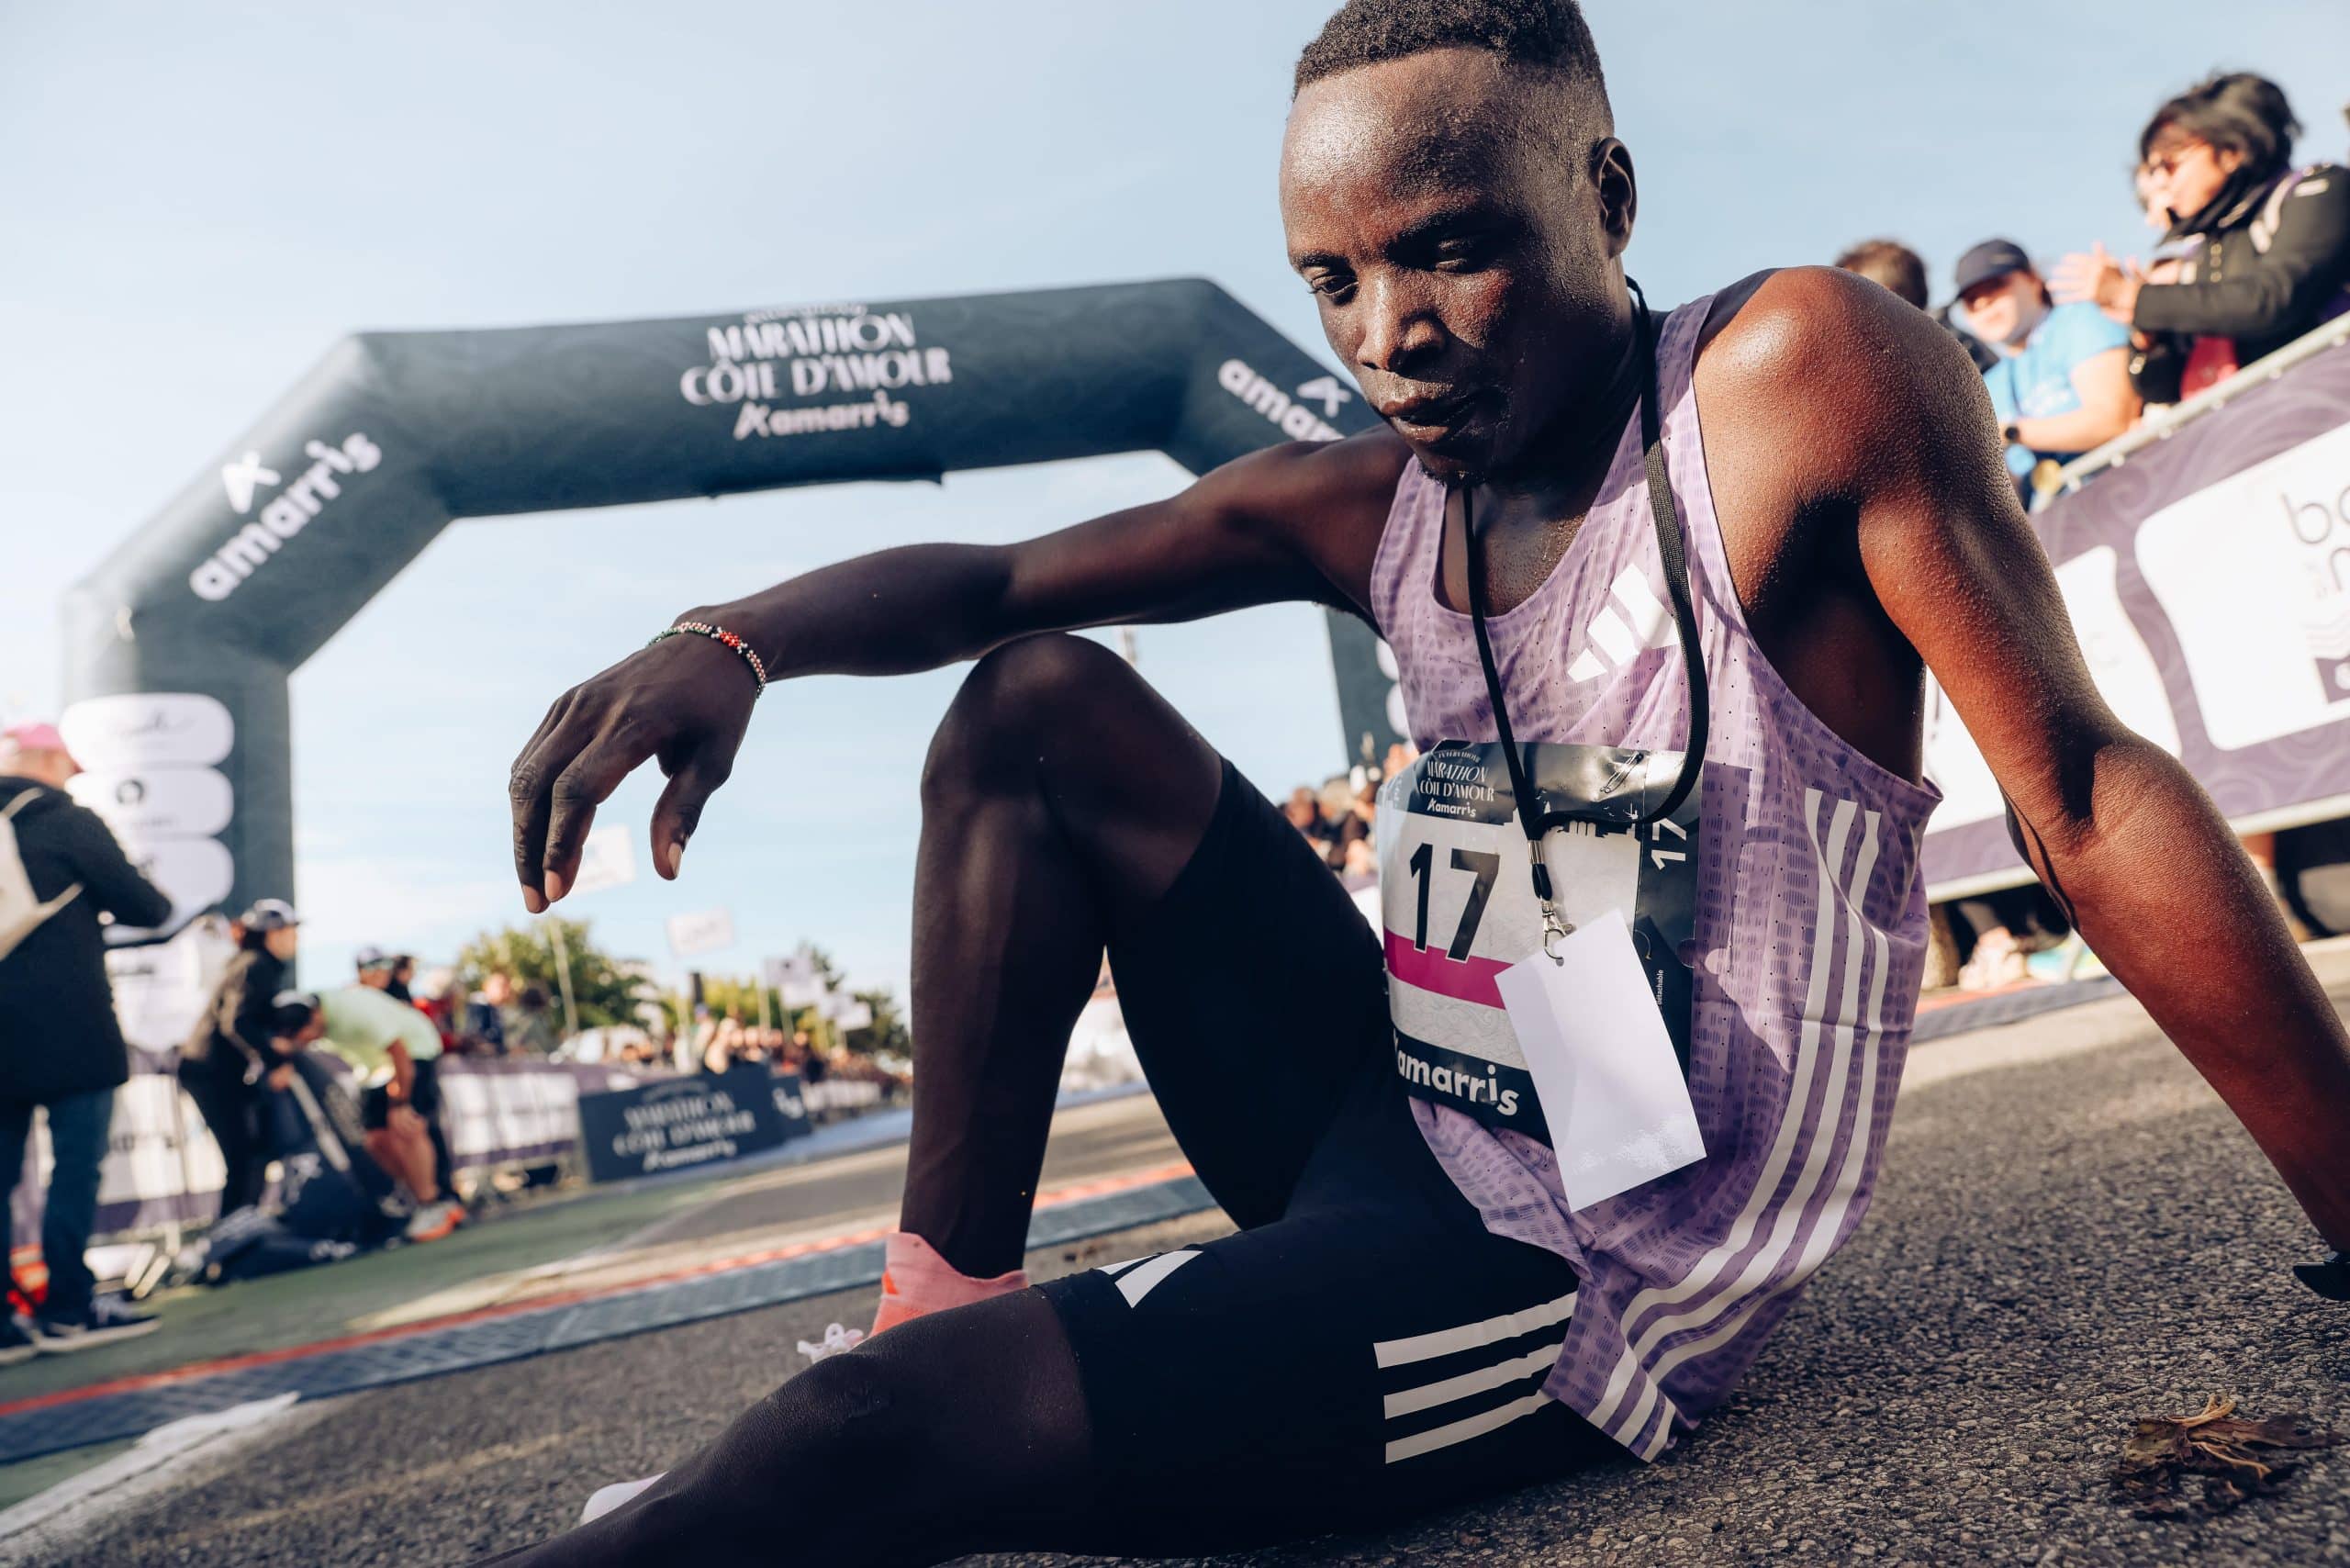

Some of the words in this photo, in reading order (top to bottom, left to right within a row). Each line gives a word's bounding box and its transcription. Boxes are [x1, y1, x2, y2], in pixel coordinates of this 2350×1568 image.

[189, 432, 382, 600] amarris
[1427, 760, 1488, 782] MARATHON
[1443, 780, 1494, 801] D'AMOUR
[1435, 801, 1477, 818] amarris
[1410, 842, 1500, 962] 17
[1398, 1049, 1519, 1116] amarris
